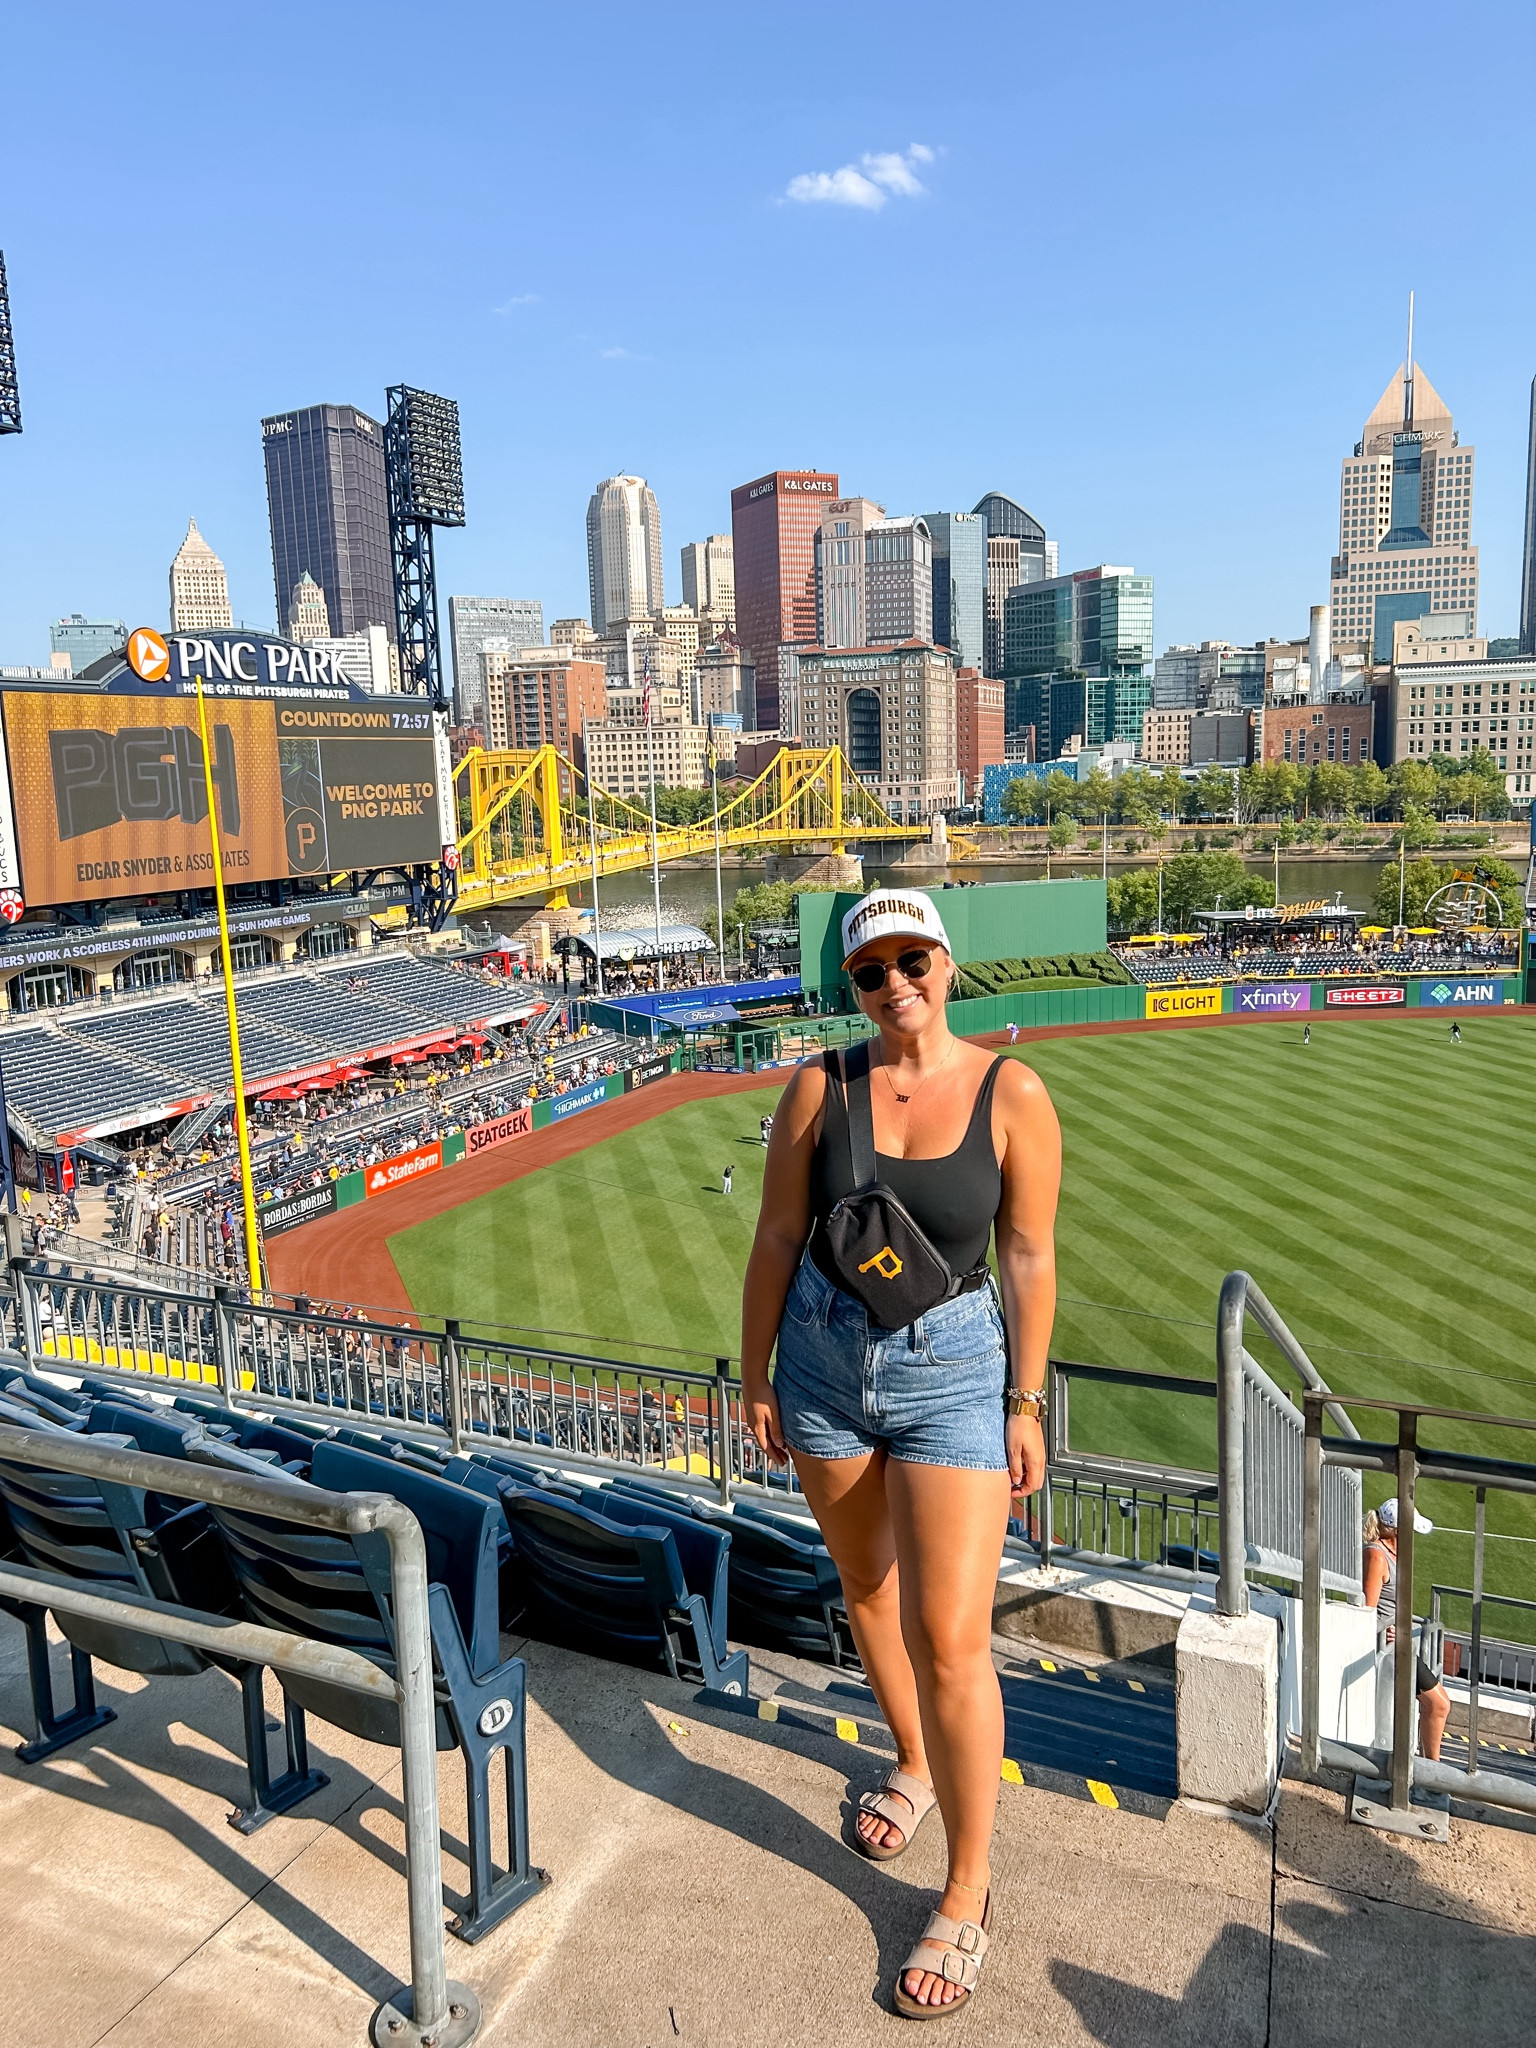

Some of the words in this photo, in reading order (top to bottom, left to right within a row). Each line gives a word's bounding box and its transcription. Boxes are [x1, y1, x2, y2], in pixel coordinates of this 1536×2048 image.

[262, 419, 293, 437] UPMC
[355, 414, 374, 434] UPMC
[749, 487, 759, 498] K&L
[758, 481, 774, 495] GATES
[784, 479, 802, 490] K&L
[803, 481, 833, 492] GATES
[964, 513, 978, 522] PNC
[173, 637, 258, 682] PNC
[262, 644, 351, 686] PARK
[183, 682, 214, 694] HOME
[218, 684, 230, 695] OF
[234, 684, 254, 696] THE
[255, 686, 313, 699] PITTSBURGH
[314, 688, 350, 700] PIRATES
[280, 710, 391, 728] COUNTDOWN
[392, 713, 430, 729] 72:57
[48, 724, 241, 842] PGH
[326, 783, 412, 802] WELCOME
[413, 782, 434, 798] TO
[341, 801, 378, 820] PNC
[380, 800, 424, 817] PARK
[297, 822, 316, 860] P
[76, 860, 122, 882] EDGAR
[123, 856, 172, 878] SNYDER
[174, 855, 184, 873] &
[185, 849, 250, 871] ASSOIATES
[392, 885, 406, 897] PM
[848, 899, 925, 943] PITTSBURGH
[1256, 907, 1275, 919] IT'S
[1273, 898, 1331, 925] Miller
[1322, 905, 1348, 917] TIME
[25, 948, 62, 965] WORK
[63, 948, 72, 958] A
[73, 938, 131, 957] SCORELESS
[132, 935, 151, 949] 4TH
[152, 930, 187, 946] INNING
[187, 925, 222, 940] DURING
[228, 920, 257, 936] RI-SUN
[257, 917, 282, 930] HOME
[282, 912, 311, 926] GAMES
[1241, 988, 1302, 1010] xfinity
[1332, 990, 1399, 1002] SHEETZ
[1453, 985, 1494, 1001] AHN
[1152, 997, 1169, 1013] IC
[1172, 995, 1216, 1011] LIGHT
[690, 1010, 718, 1021] Ford
[642, 1064, 664, 1080] BETMGM
[556, 1092, 594, 1115] HIGHMARK
[469, 1111, 529, 1153] SEATGEEK
[263, 1202, 298, 1228] BORDAS
[300, 1189, 332, 1213] BORDAS
[488, 1706, 505, 1729] D
